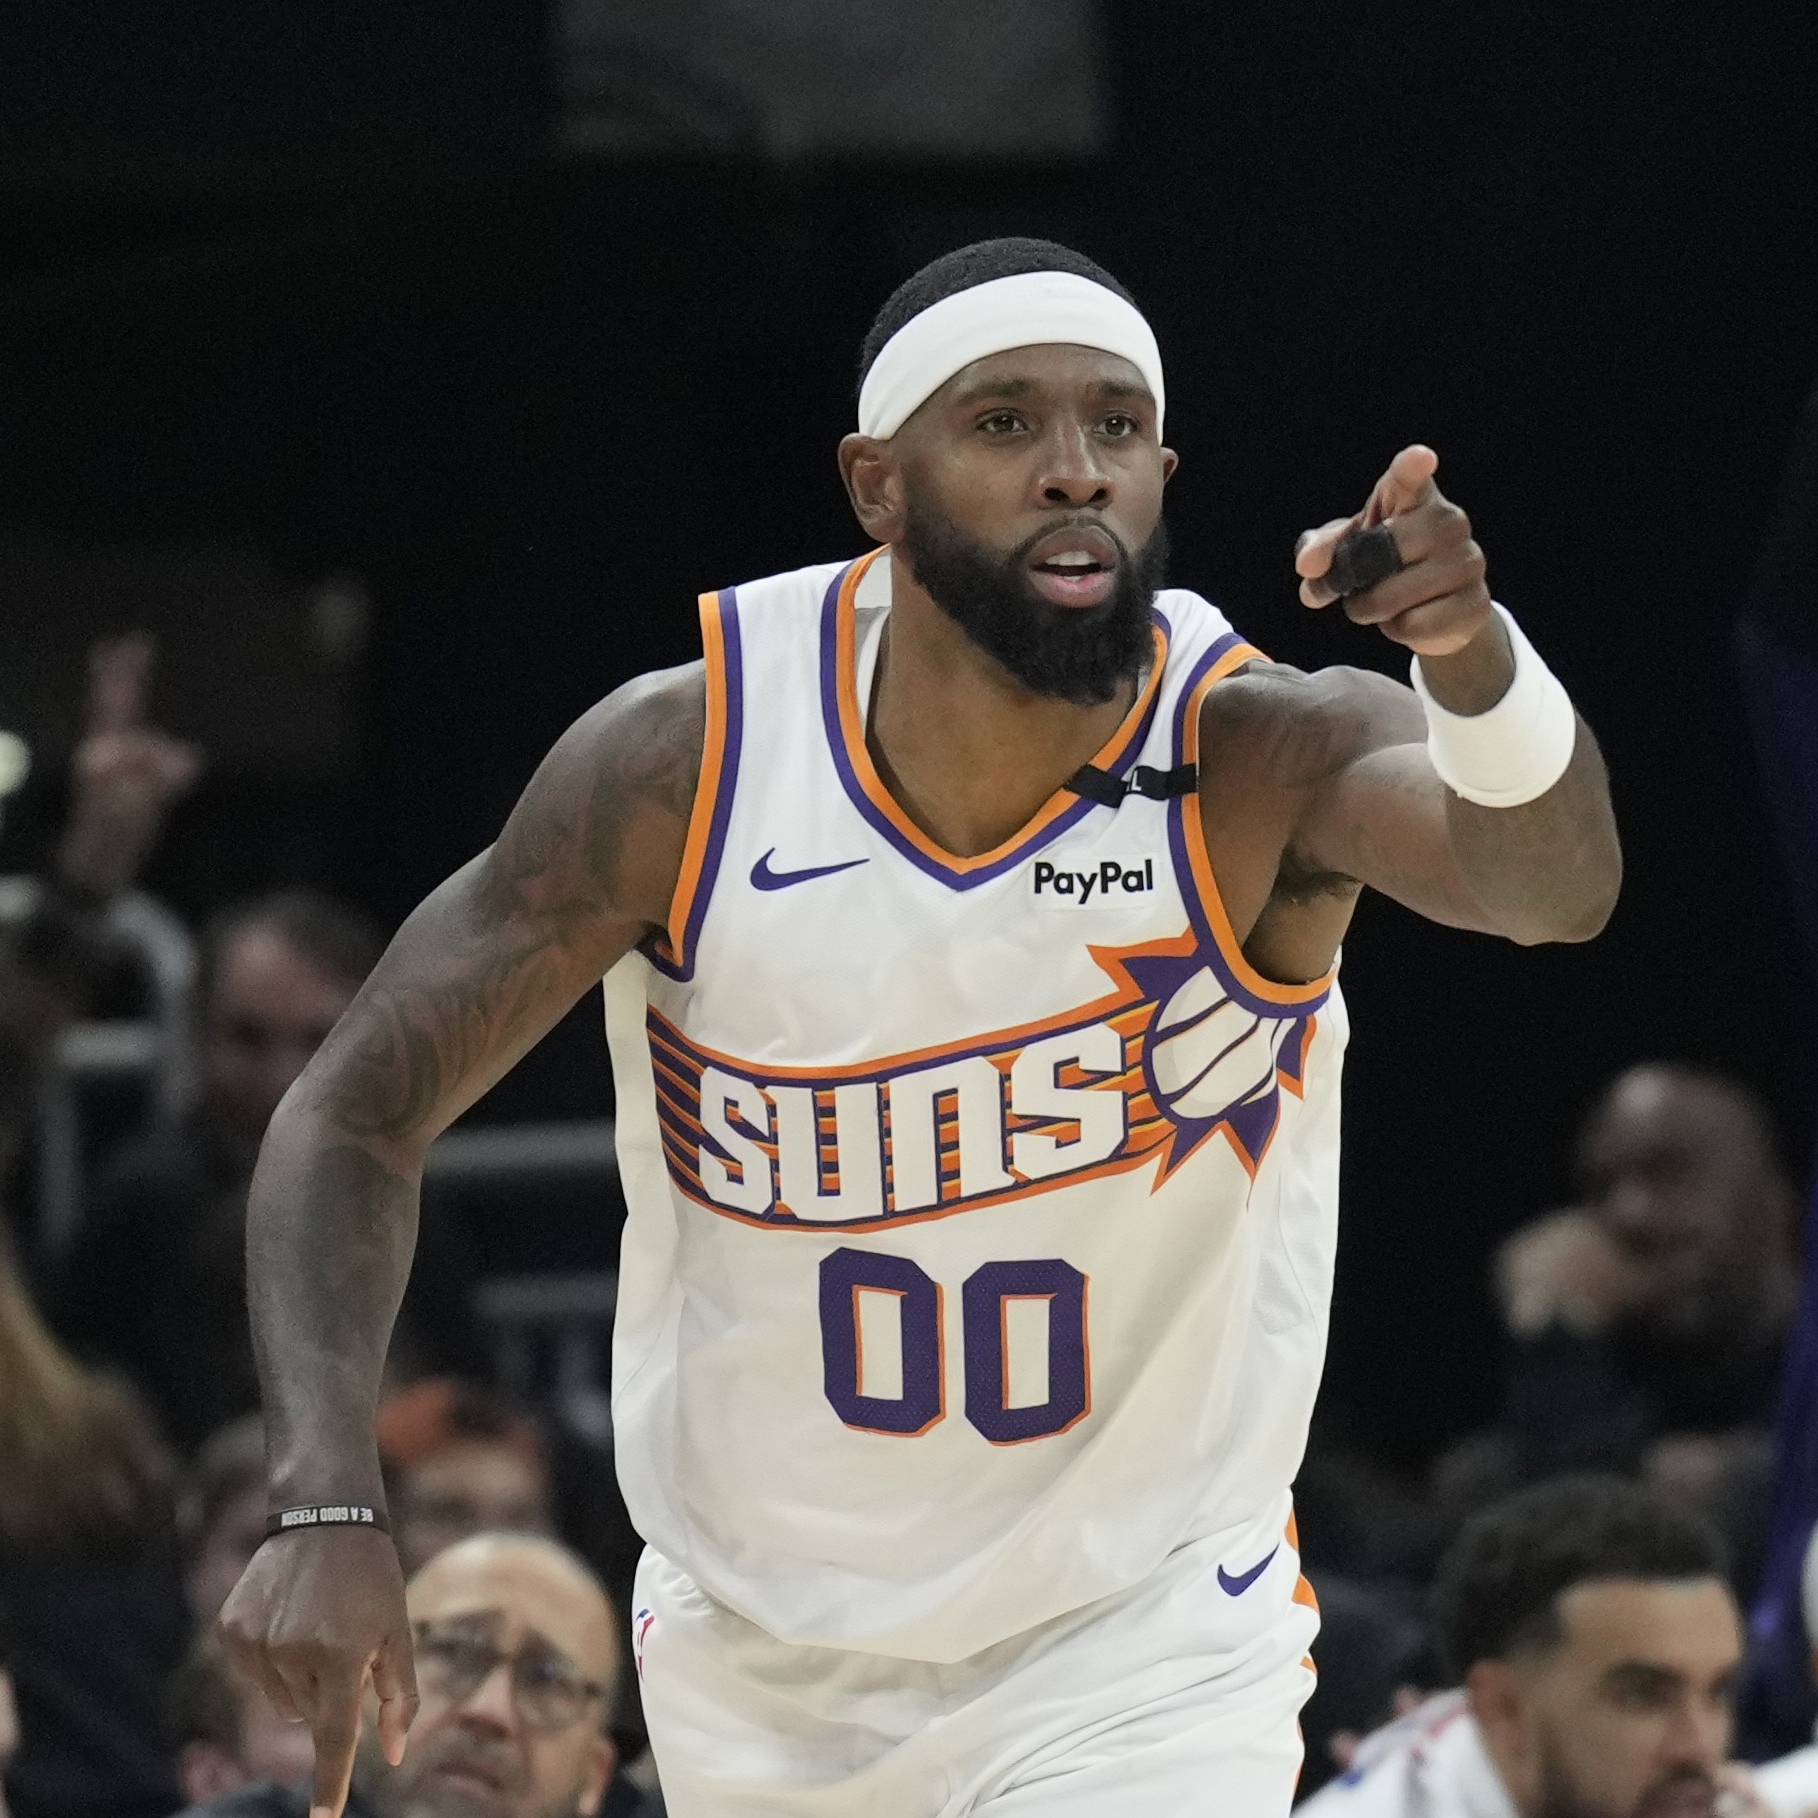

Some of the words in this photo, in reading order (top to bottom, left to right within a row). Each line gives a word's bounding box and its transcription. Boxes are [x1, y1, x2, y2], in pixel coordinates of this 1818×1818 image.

[1034, 859, 1153, 904] PayPal
[697, 1022, 1128, 1221] SUNS
[819, 1247, 1091, 1447] 00
[319, 1506, 349, 1522] GOOD
[350, 1506, 359, 1521] A
[360, 1507, 374, 1523] BE
